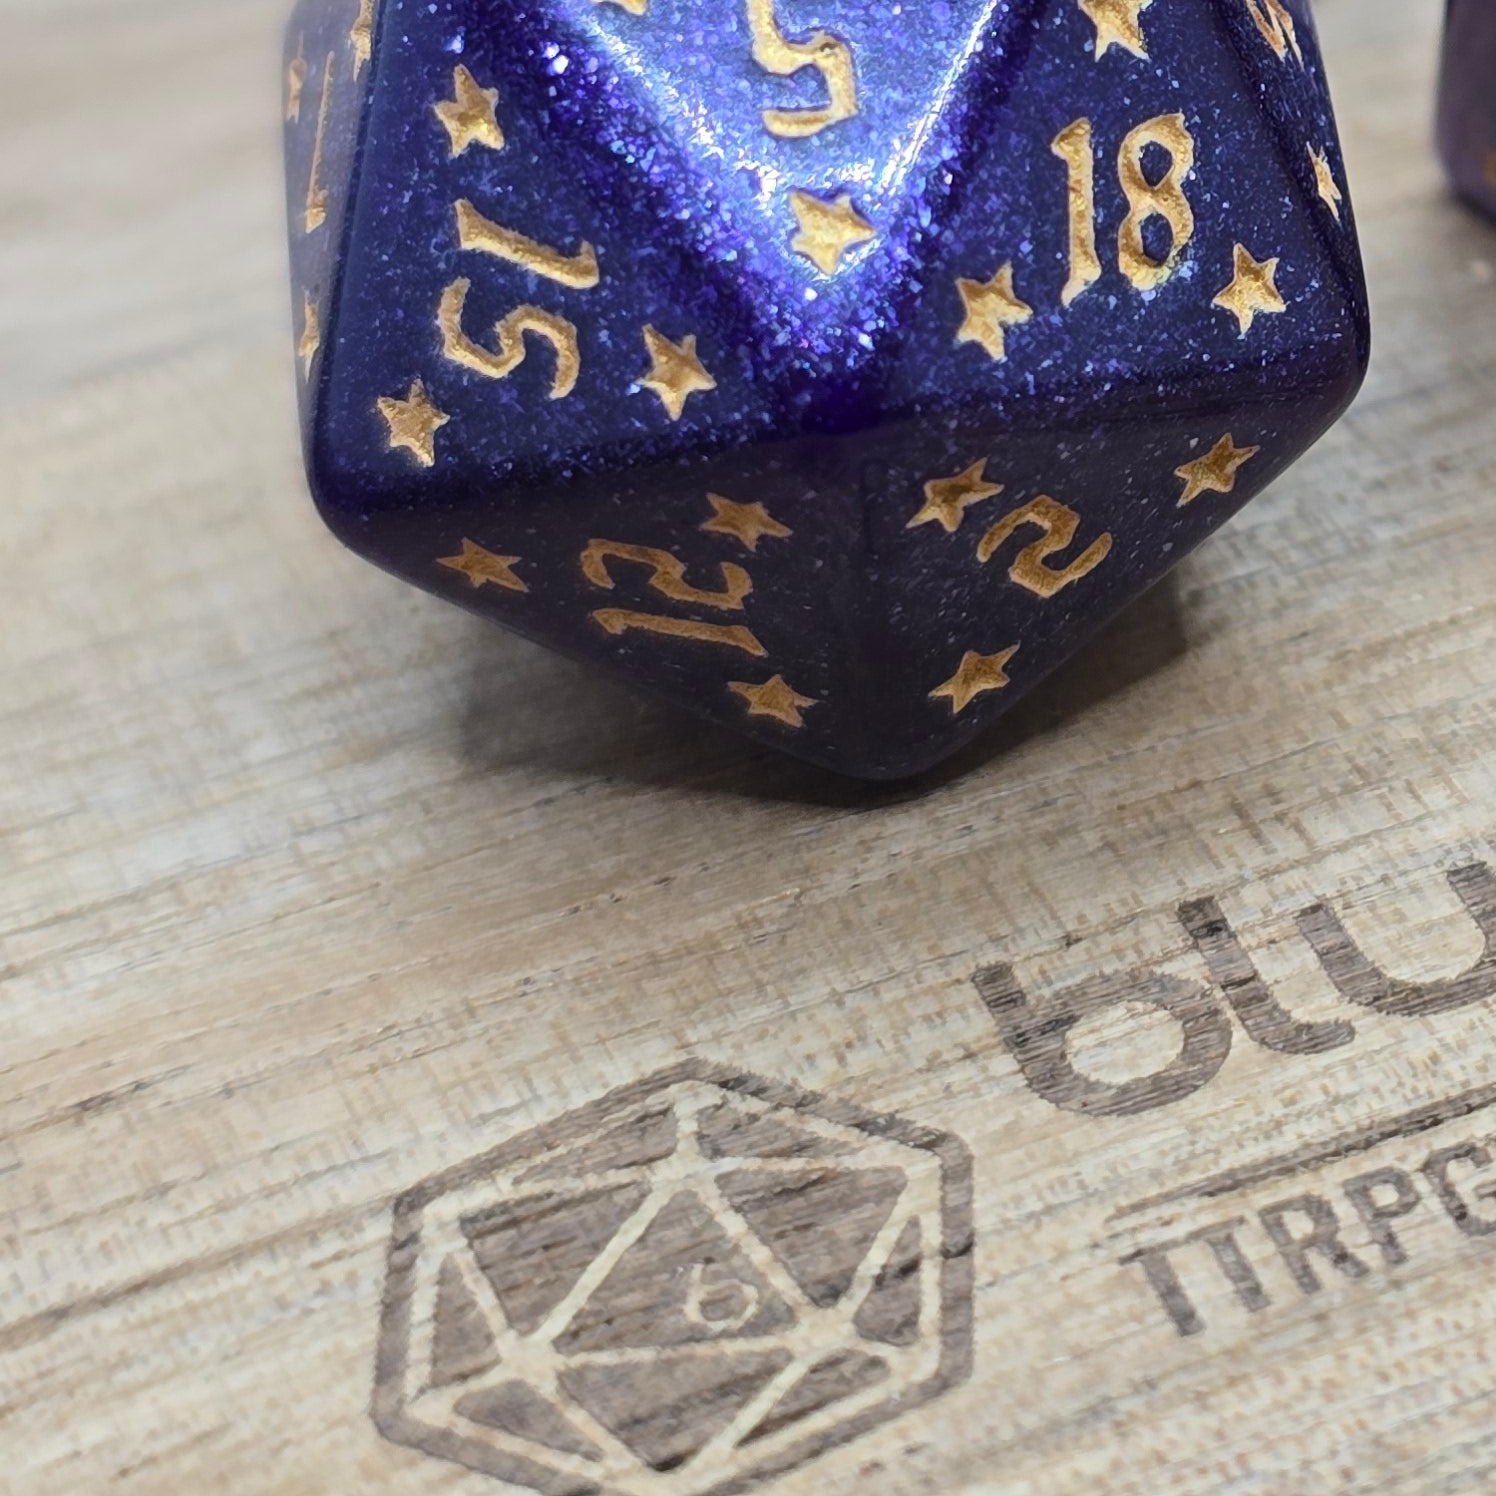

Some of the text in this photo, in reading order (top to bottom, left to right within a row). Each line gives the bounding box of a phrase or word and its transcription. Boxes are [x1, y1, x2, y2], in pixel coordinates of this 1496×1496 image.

[1050, 112, 1197, 307] 18
[436, 197, 600, 400] 15
[578, 534, 767, 657] 12
[976, 494, 1114, 598] 2
